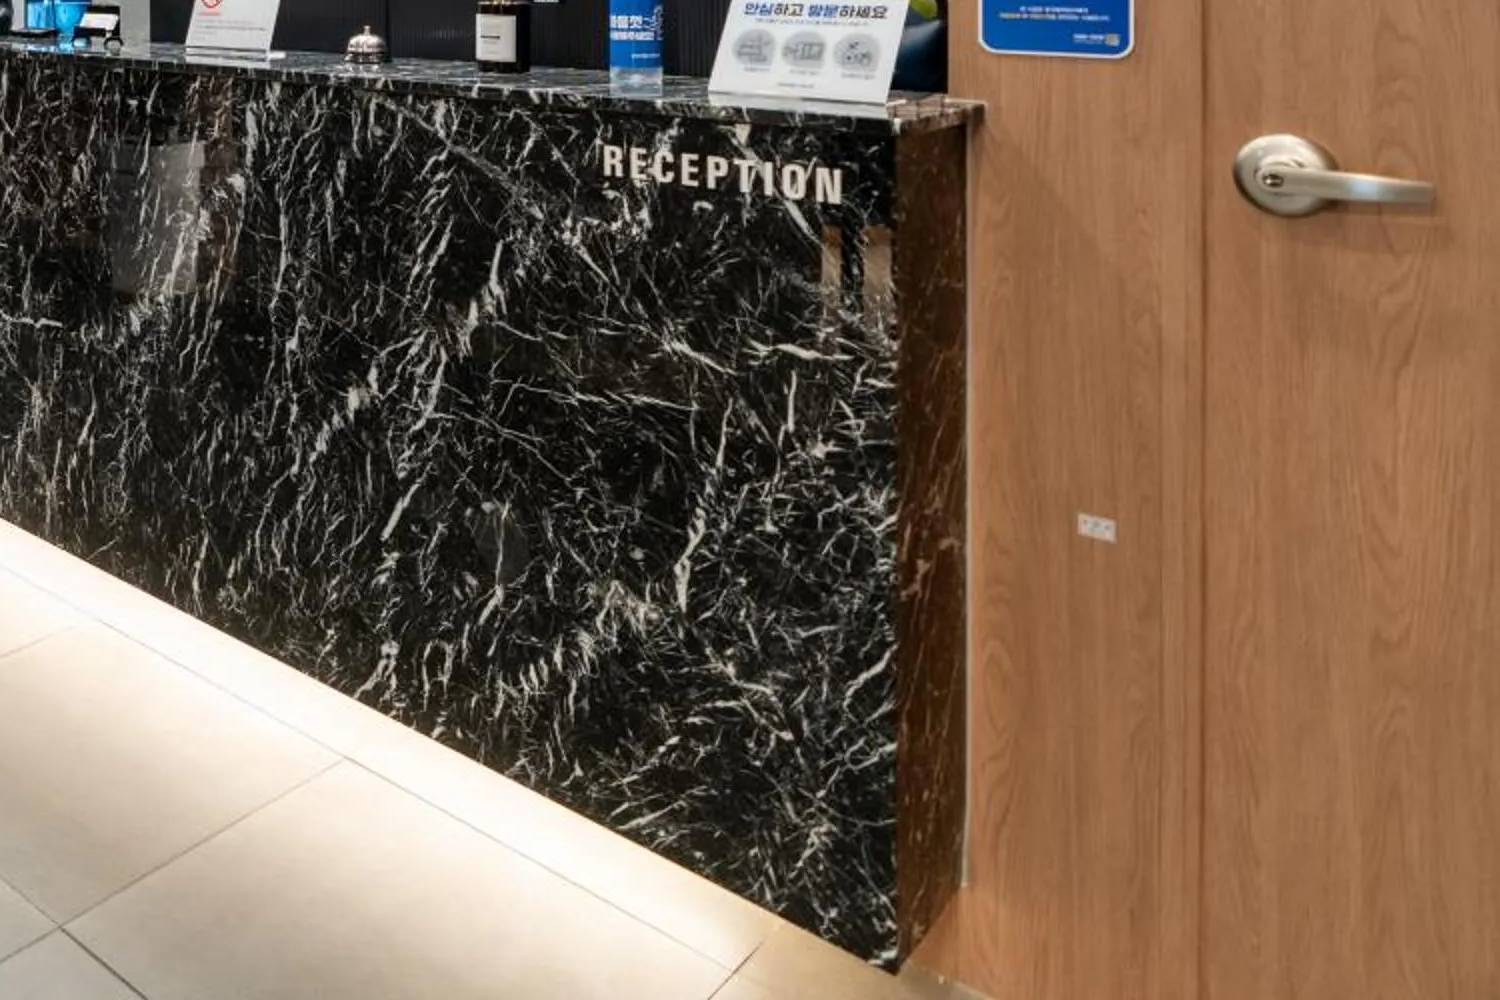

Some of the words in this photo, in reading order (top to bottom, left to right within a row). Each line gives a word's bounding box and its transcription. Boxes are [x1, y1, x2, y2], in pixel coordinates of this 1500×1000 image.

[744, 2, 805, 16] 안심하고
[807, 3, 888, 19] 방문하세요
[603, 145, 842, 204] RECEPTION
